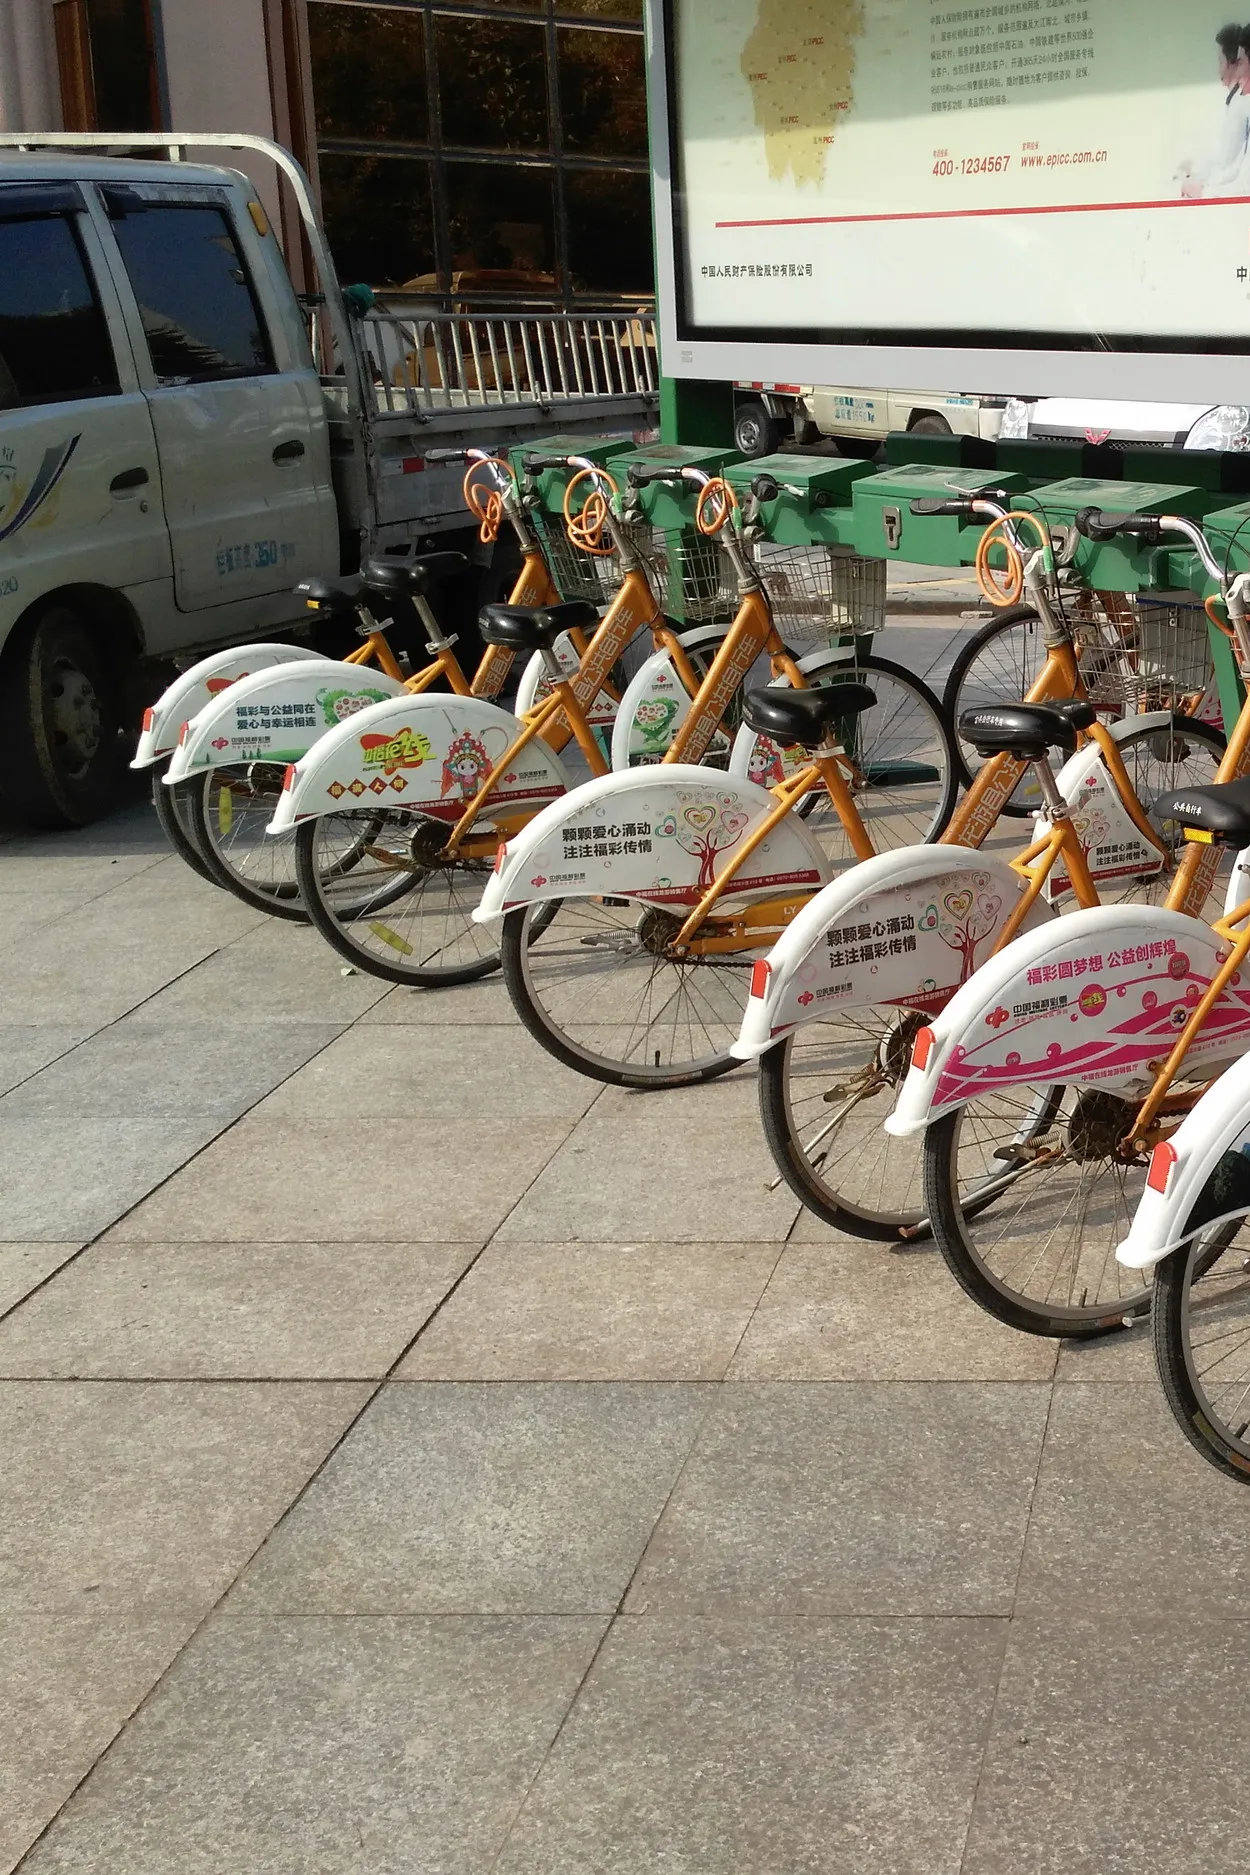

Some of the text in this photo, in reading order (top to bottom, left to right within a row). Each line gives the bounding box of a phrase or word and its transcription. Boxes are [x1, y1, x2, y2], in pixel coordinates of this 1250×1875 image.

[932, 155, 1010, 177] 400-1234567
[1020, 150, 1107, 169] www.epicc.com.cn
[701, 263, 813, 278] 中国人民财产保险股份有限公司
[236, 703, 316, 717] 福彩与公益同在
[237, 717, 316, 730] 爱心与幸运相连
[1172, 801, 1202, 816] 公共自行车
[562, 821, 651, 842] 颗颗爱心涌动
[563, 838, 652, 860] 注注福彩传情
[827, 914, 914, 948] 颗颗爱心涌动
[830, 935, 917, 969] 注注福彩传情
[1027, 955, 1104, 986] 福彩圆梦想
[1107, 939, 1177, 970] 公益创辉煌
